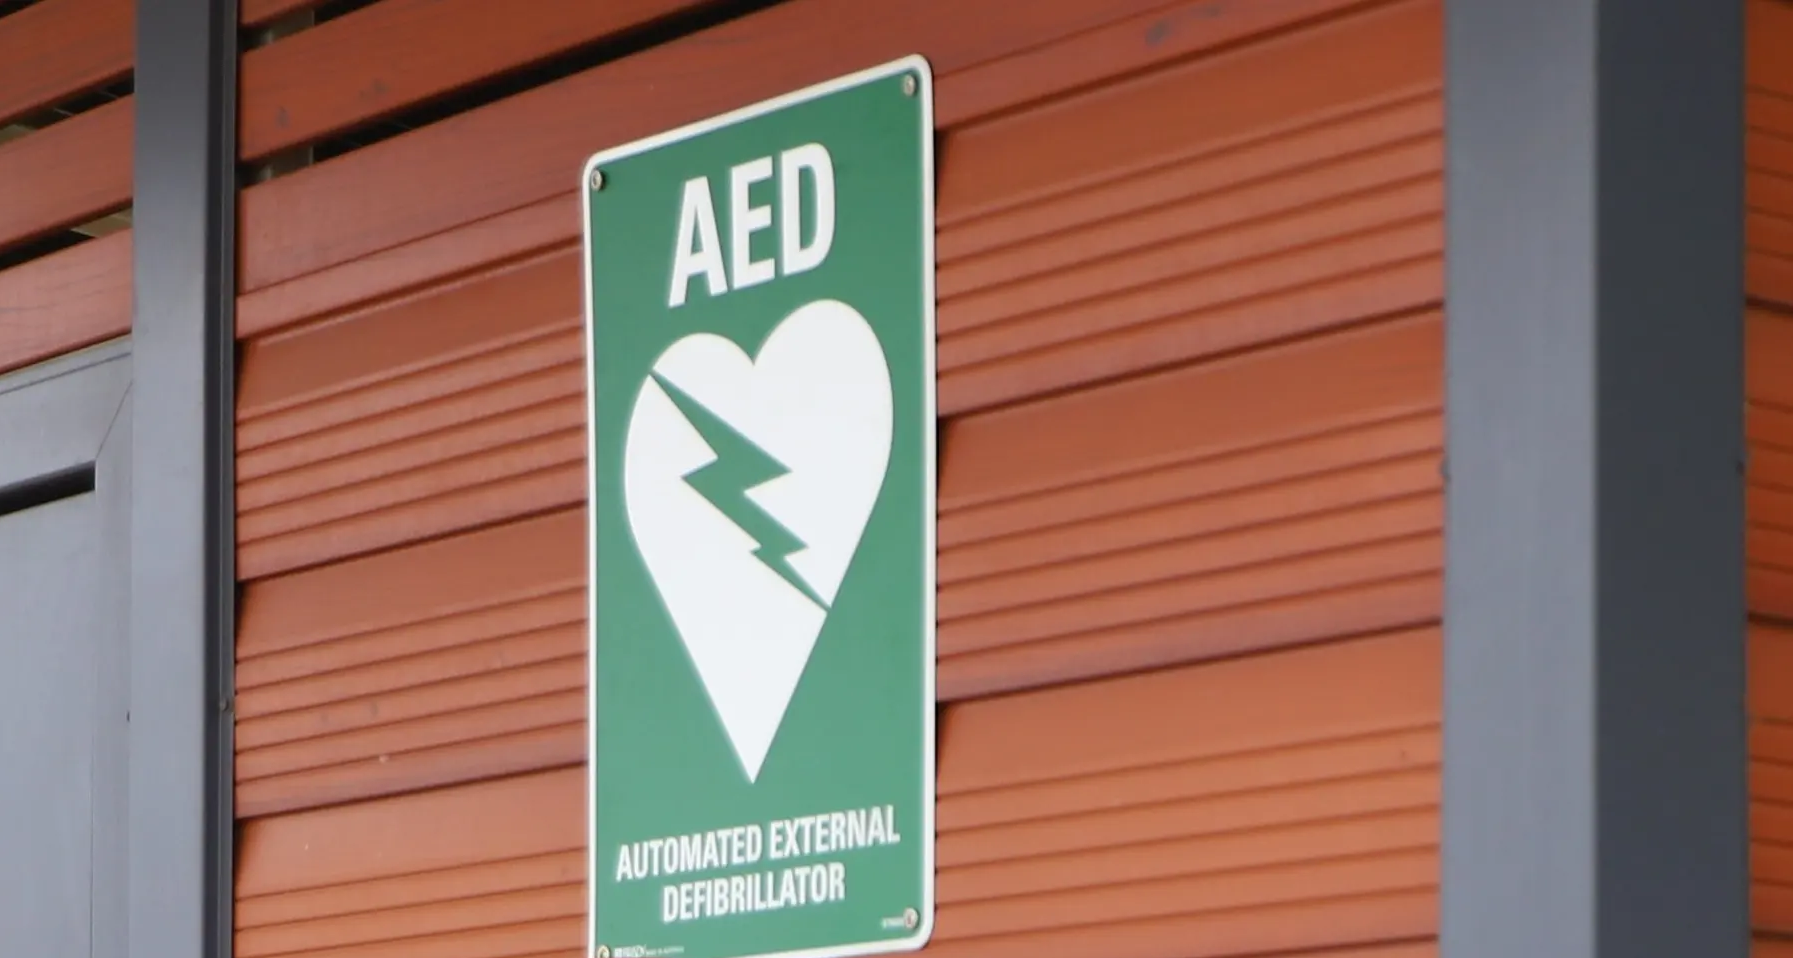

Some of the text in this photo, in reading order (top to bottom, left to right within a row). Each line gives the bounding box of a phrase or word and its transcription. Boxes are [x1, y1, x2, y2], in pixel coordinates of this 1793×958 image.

[668, 142, 835, 308] AED
[617, 804, 901, 882] AUTOMATED EXTERNAL
[662, 862, 846, 923] DEFIBRILLATOR
